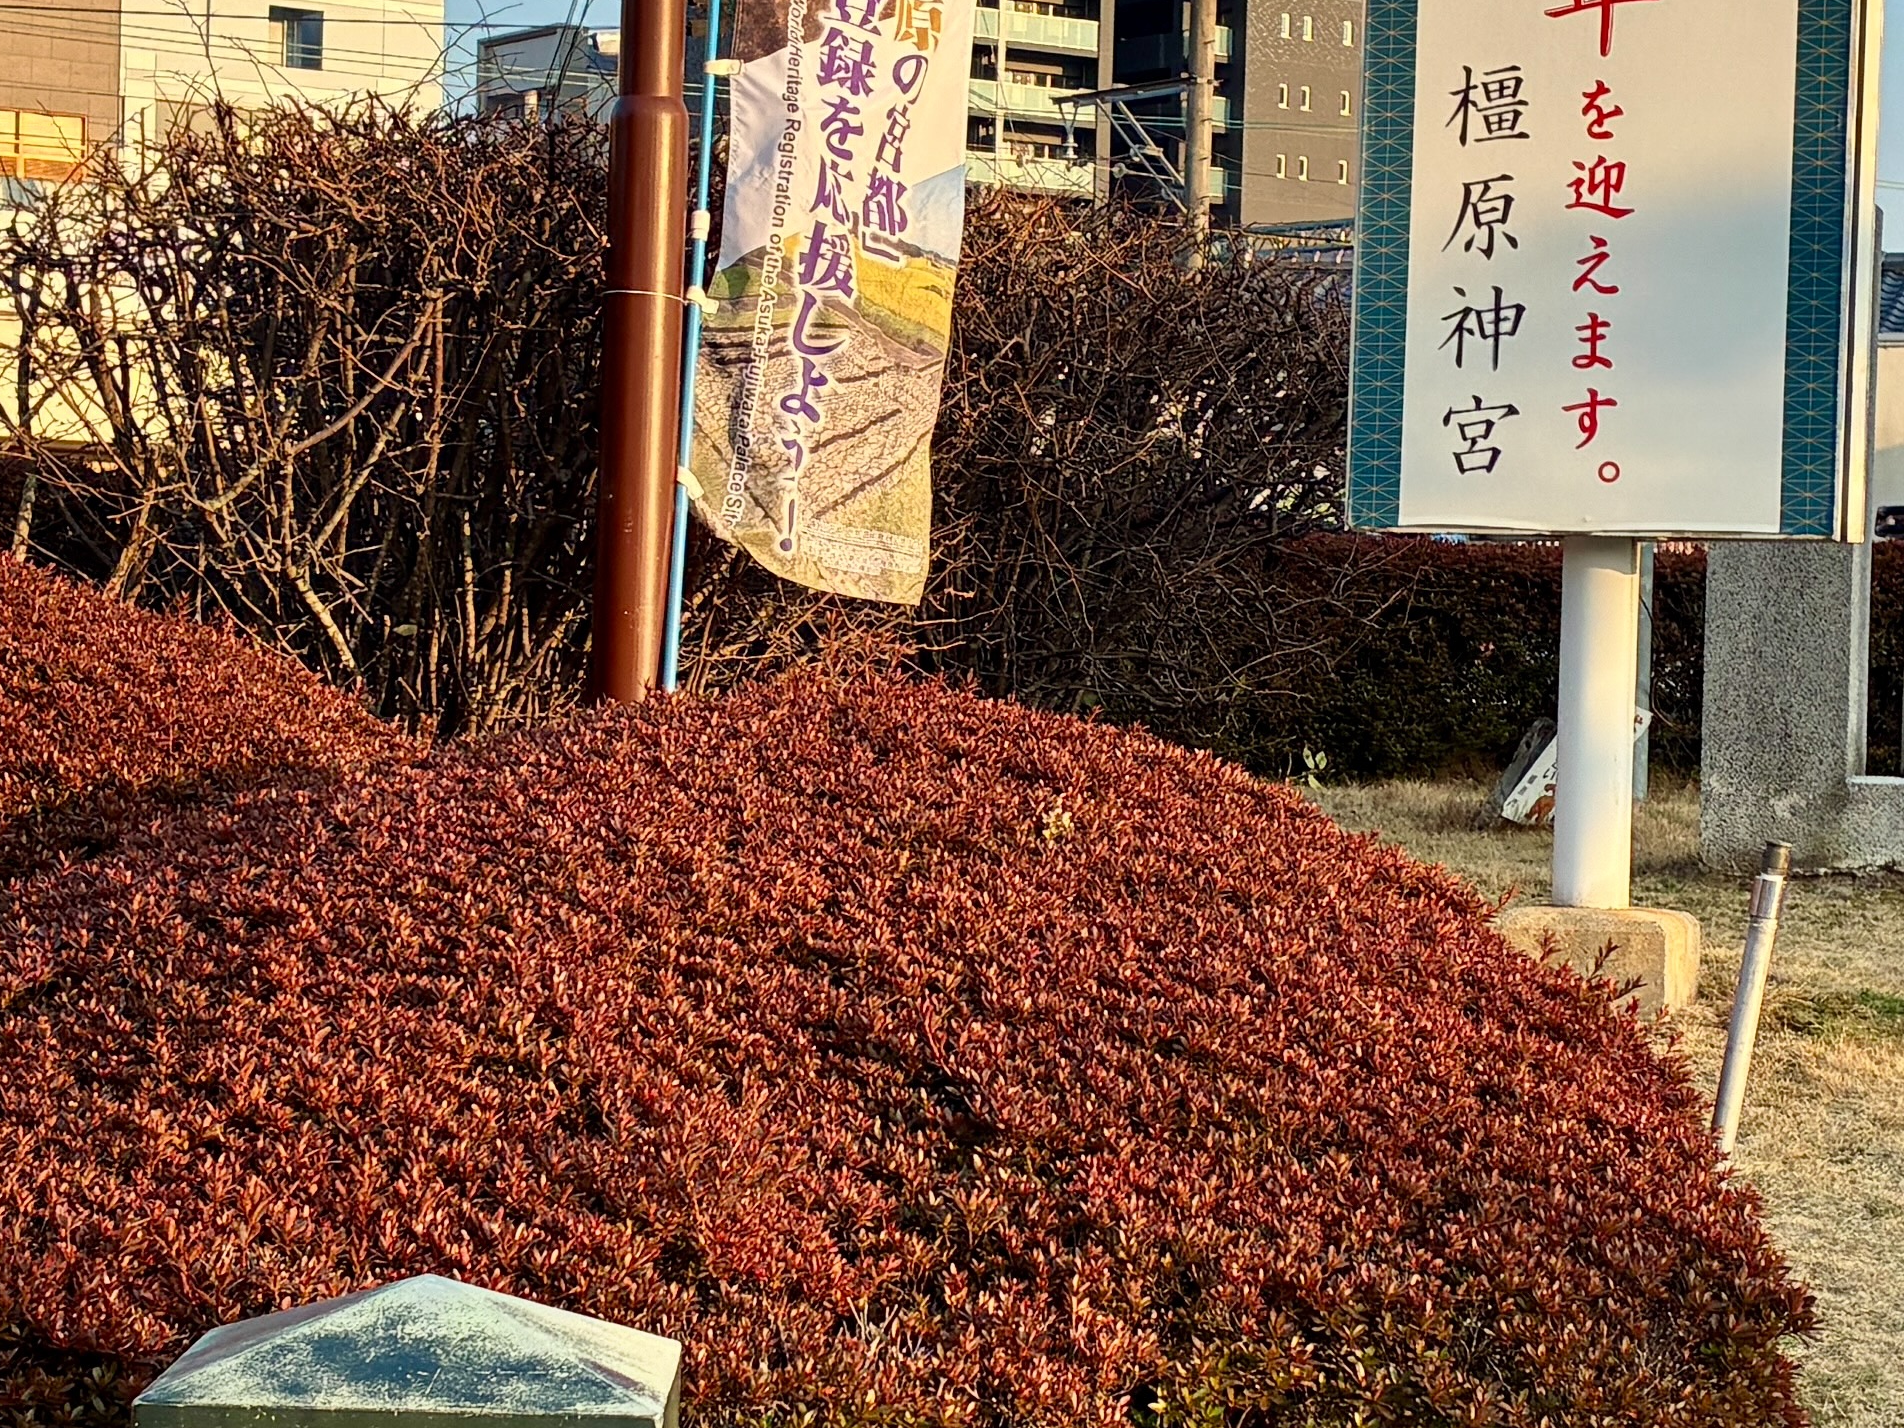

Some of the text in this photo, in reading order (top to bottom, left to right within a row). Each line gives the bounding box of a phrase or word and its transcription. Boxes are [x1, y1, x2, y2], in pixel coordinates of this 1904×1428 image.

[782, 42, 803, 113] Heritage
[771, 119, 801, 228] Registration
[763, 255, 780, 285] the
[769, 234, 783, 253] of
[1437, 64, 1530, 476] 橿原神宮
[738, 290, 776, 430] Asuka-Fujiwara
[729, 434, 751, 492] Palace
